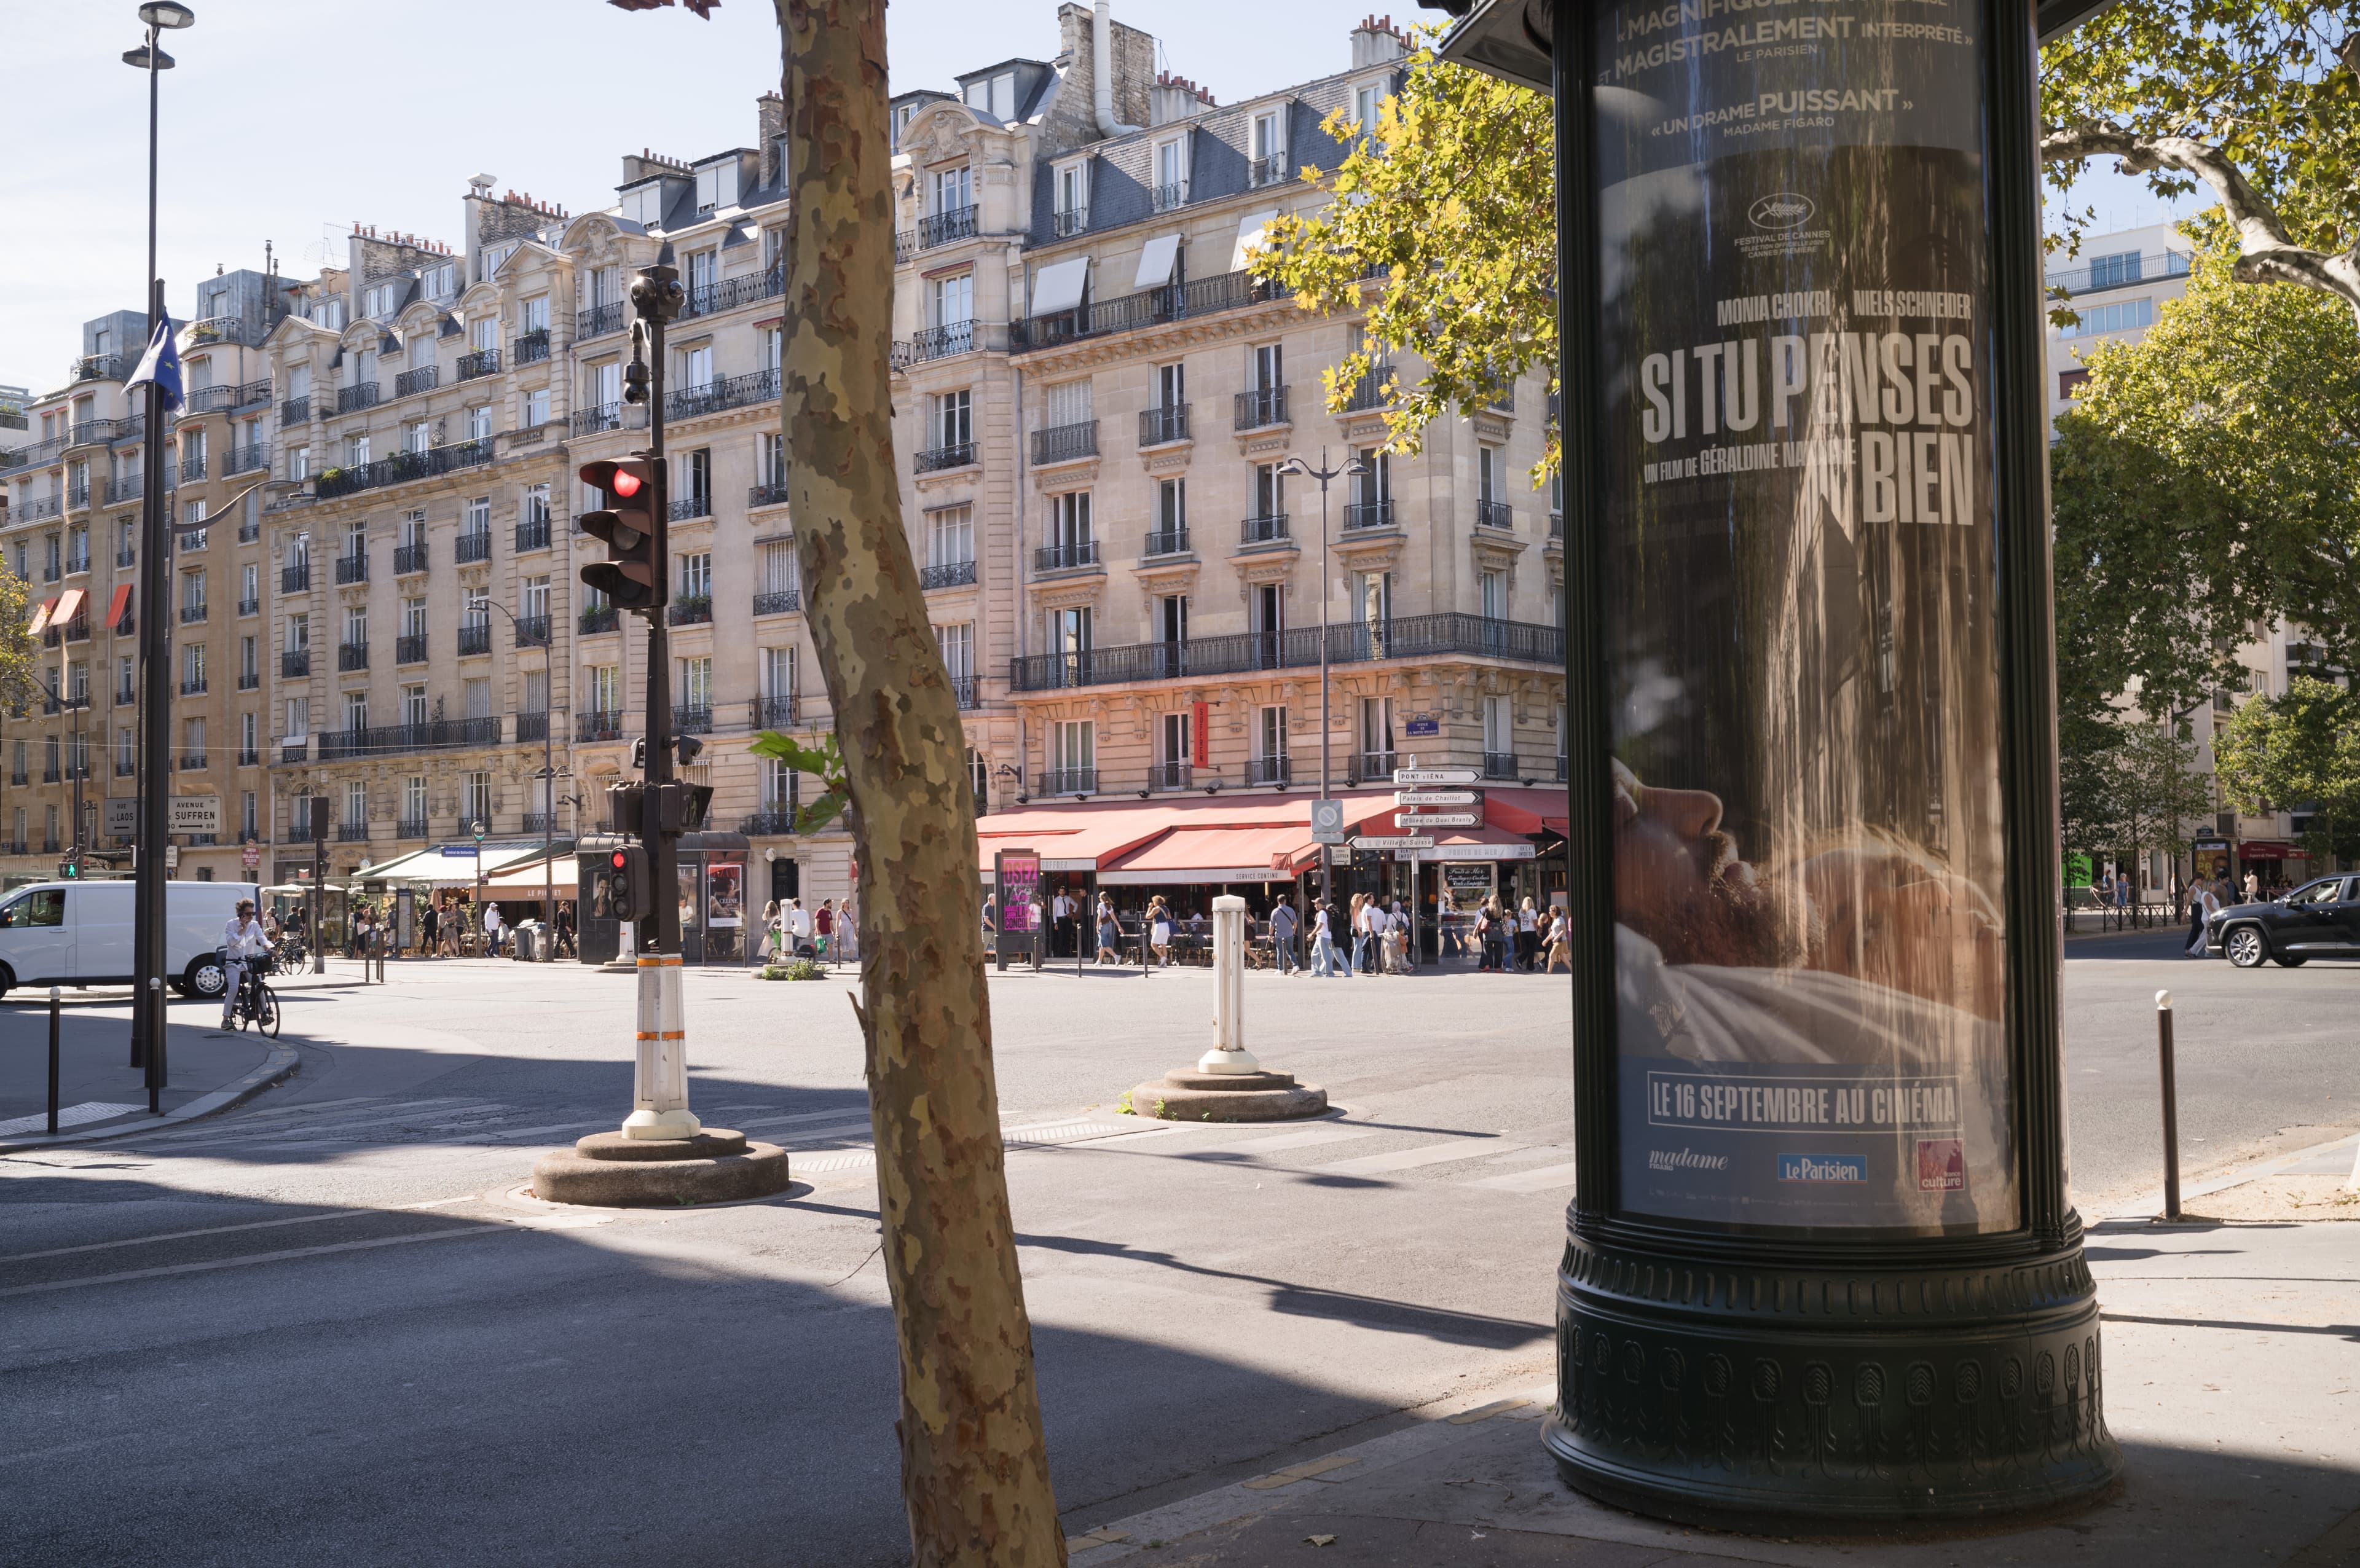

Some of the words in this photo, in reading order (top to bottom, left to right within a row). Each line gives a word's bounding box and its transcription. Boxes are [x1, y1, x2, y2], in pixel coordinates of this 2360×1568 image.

[1615, 16, 1855, 79] MAGISTRALEMENT
[1736, 50, 1752, 63] LE
[1756, 44, 1817, 60] PARISIEN
[1692, 103, 1756, 129] DRAME
[1759, 89, 1899, 116] PUISSANT
[1723, 120, 1780, 138] MADAME
[1784, 117, 1835, 130] FIGARO
[1734, 234, 1776, 246] FESTIVAL
[1792, 230, 1831, 240] CANNES
[1748, 249, 1778, 258] CANNES
[1717, 295, 1769, 326] MONIA
[1772, 290, 1830, 319] CHOKRI
[1854, 289, 1894, 316] NIELS
[1896, 291, 1971, 319] SCHNEIDER
[1641, 349, 1686, 443] SI
[1694, 339, 1759, 435] TU
[1771, 332, 1972, 427] PENSES
[1644, 463, 1659, 484] UN
[1661, 459, 1683, 481] FILM
[1685, 457, 1697, 477] DE
[1700, 444, 1778, 476] GÉRALDINE
[1861, 431, 1973, 525] BIEN
[1004, 861, 1037, 884] OSEZ
[1654, 1081, 1670, 1116] LE
[1675, 1083, 1695, 1118] 16
[1701, 1085, 1828, 1123] SEPTEMBRE
[1835, 1088, 1865, 1124] AU
[1872, 1081, 1956, 1124] CINÉMA
[1649, 1148, 1728, 1170] madame
[1786, 1162, 1800, 1179] Le
[1801, 1158, 1858, 1180] Parisien
[1922, 1175, 1961, 1188] culture
